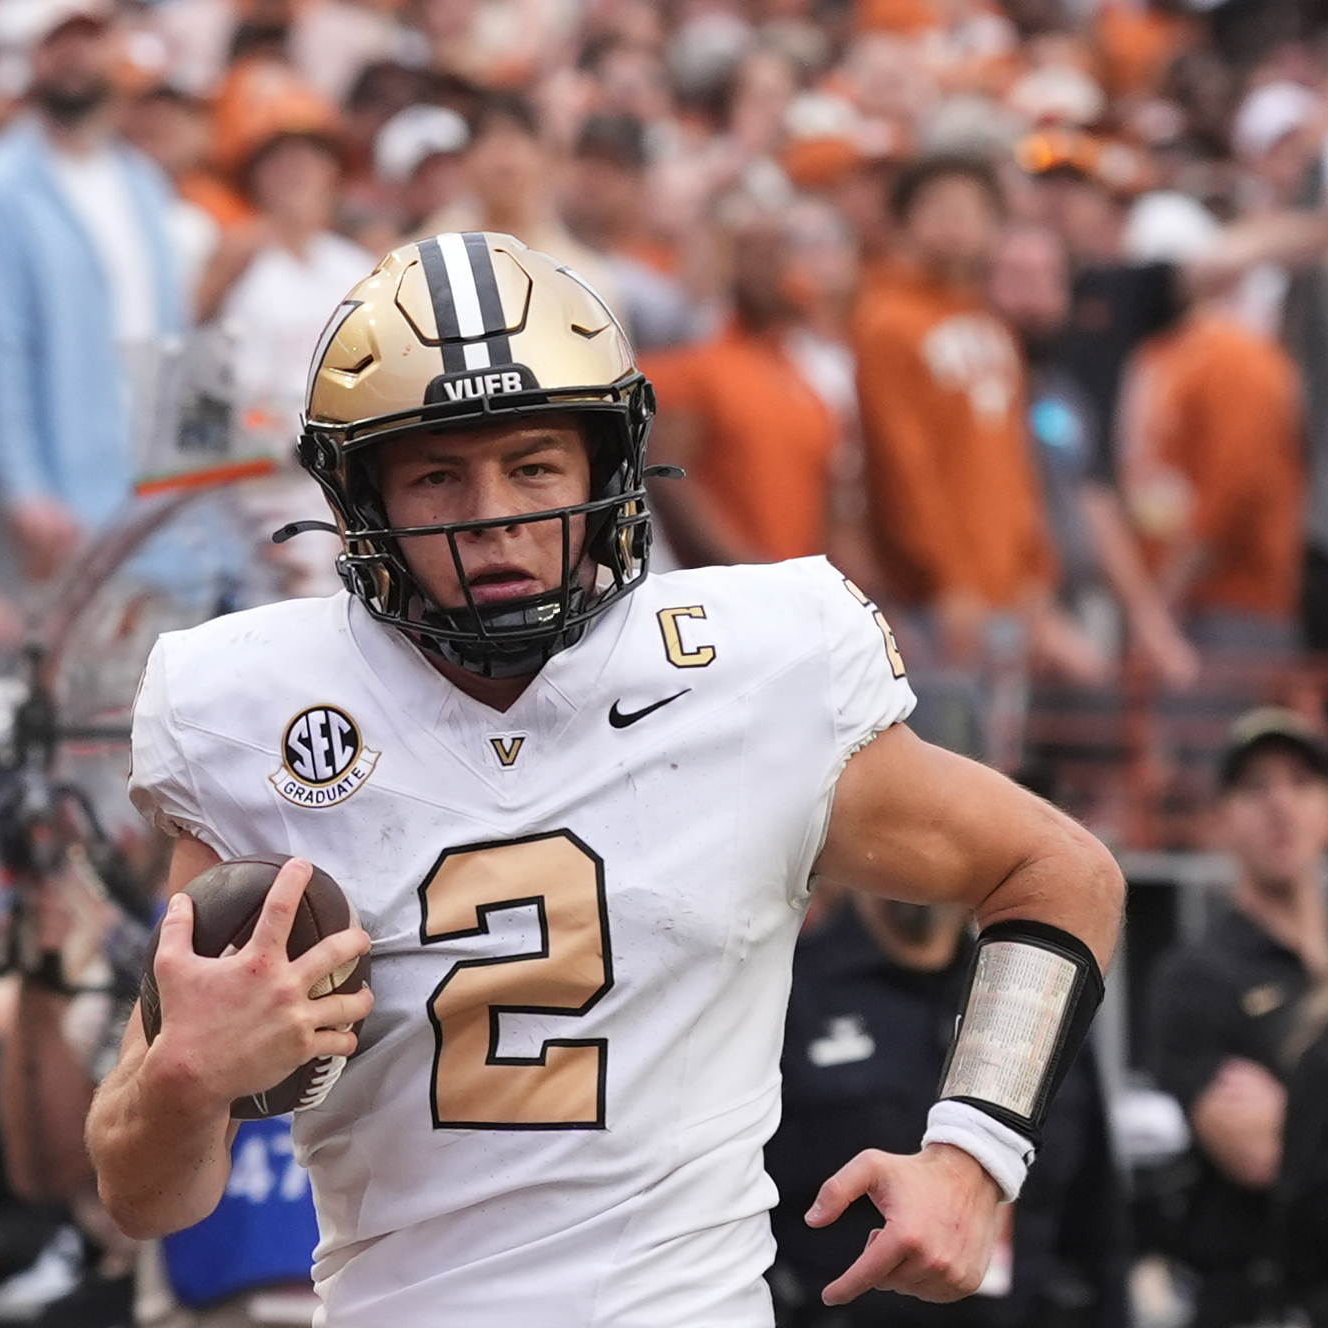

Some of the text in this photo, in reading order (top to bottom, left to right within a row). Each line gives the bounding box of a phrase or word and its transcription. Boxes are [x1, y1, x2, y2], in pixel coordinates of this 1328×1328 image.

[443, 371, 523, 402] VUFB
[656, 605, 717, 669] C
[287, 709, 355, 781] SEC
[489, 736, 526, 767] V
[283, 766, 366, 804] GRADUATE
[417, 827, 615, 1131] 2
[226, 1132, 308, 1203] 47
